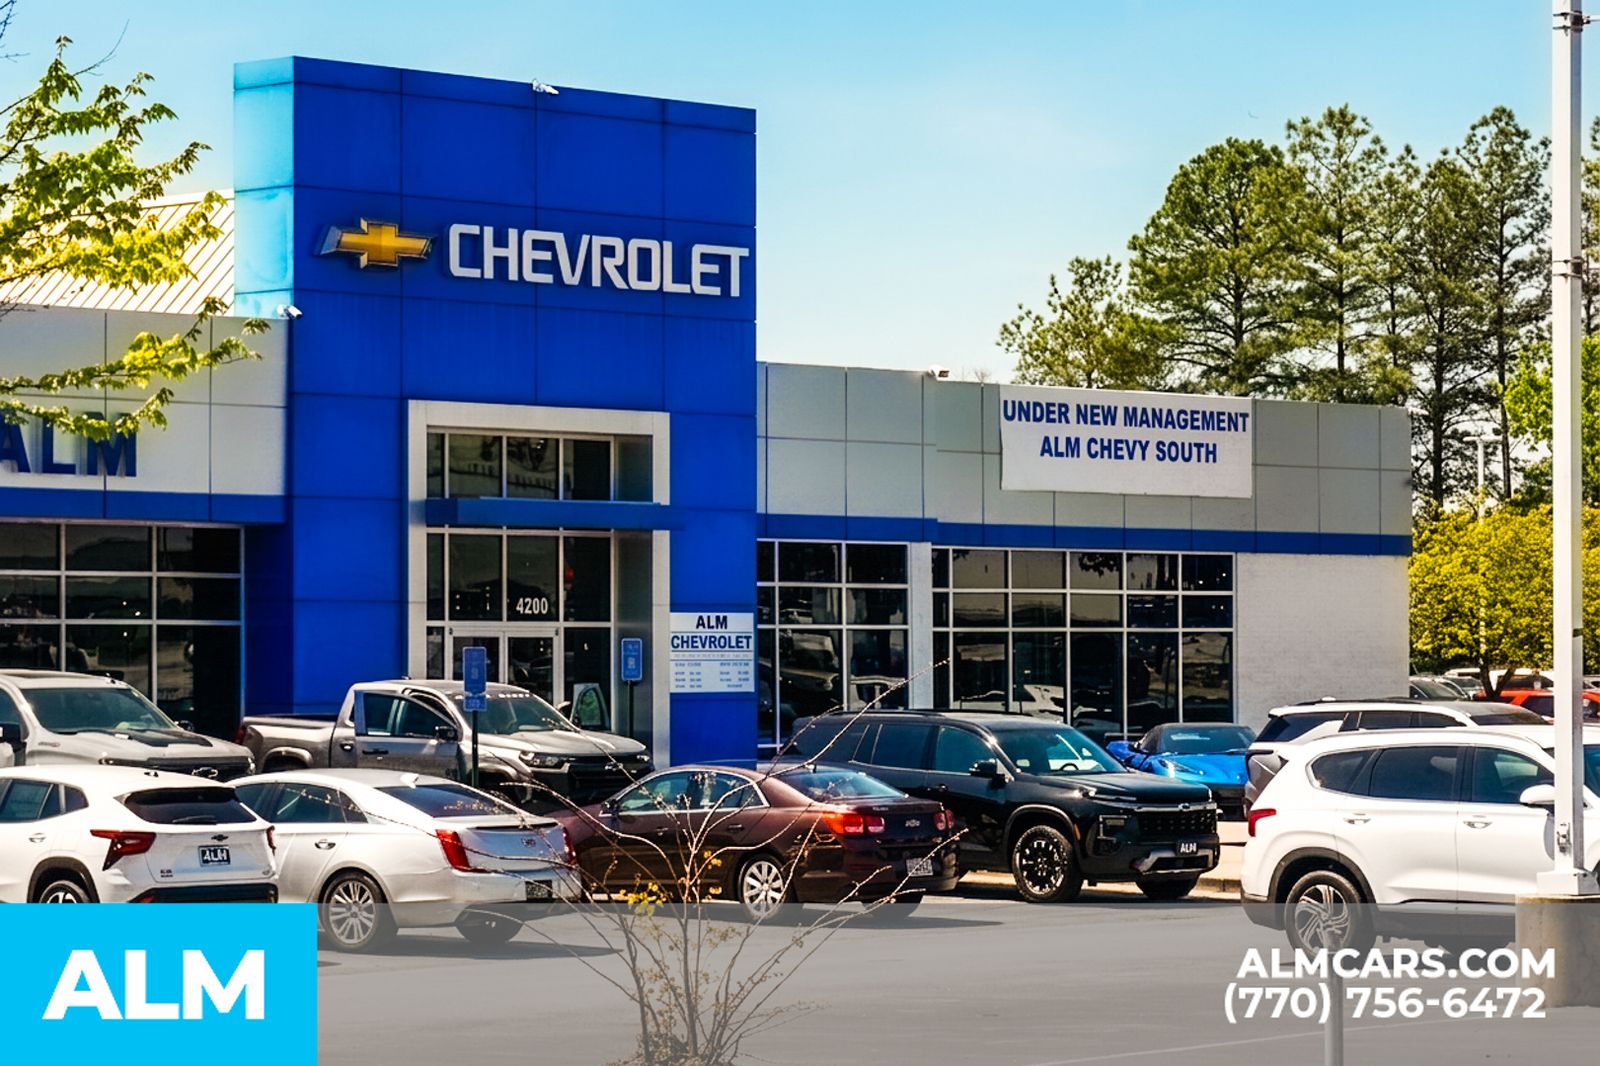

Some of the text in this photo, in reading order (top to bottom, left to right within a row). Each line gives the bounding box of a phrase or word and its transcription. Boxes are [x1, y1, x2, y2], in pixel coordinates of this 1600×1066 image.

[449, 223, 749, 297] CHEVROLET
[1003, 400, 1249, 432] UNDER NEW MANAGEMENT
[0, 409, 137, 477] ALM
[1040, 435, 1217, 463] ALM CHEVY SOUTH
[515, 598, 549, 614] 4200
[695, 615, 728, 629] ALM
[671, 635, 752, 649] CHEVROLET
